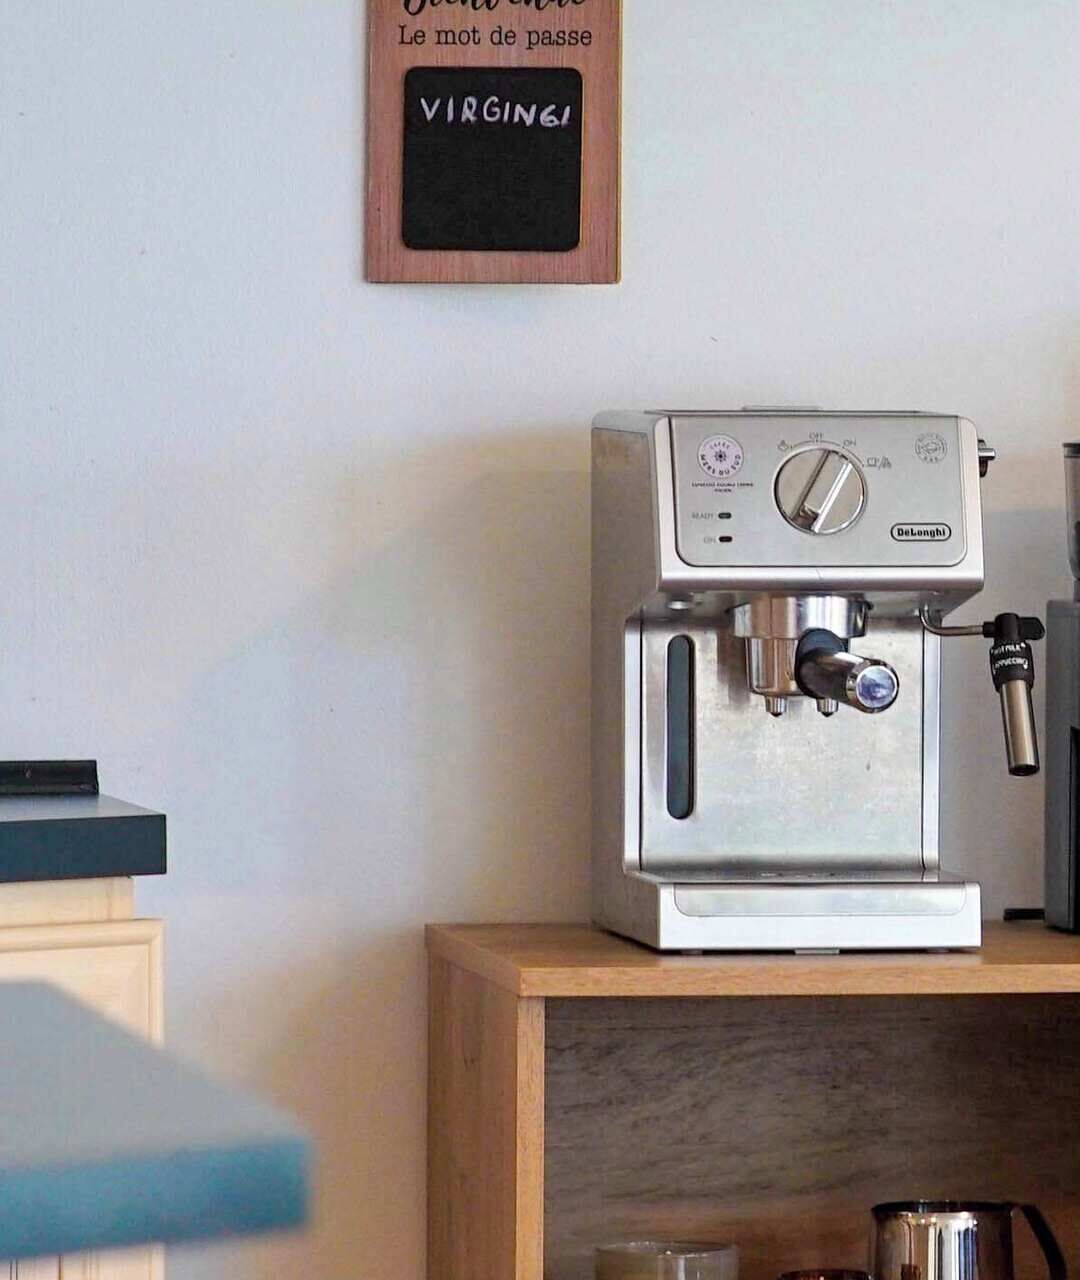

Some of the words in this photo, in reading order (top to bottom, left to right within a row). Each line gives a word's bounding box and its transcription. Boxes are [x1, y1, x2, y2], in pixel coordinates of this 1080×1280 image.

[399, 24, 426, 46] Le
[434, 26, 481, 46] mot
[490, 25, 516, 46] de
[526, 29, 592, 50] passe
[897, 528, 946, 539] DeLonghi
